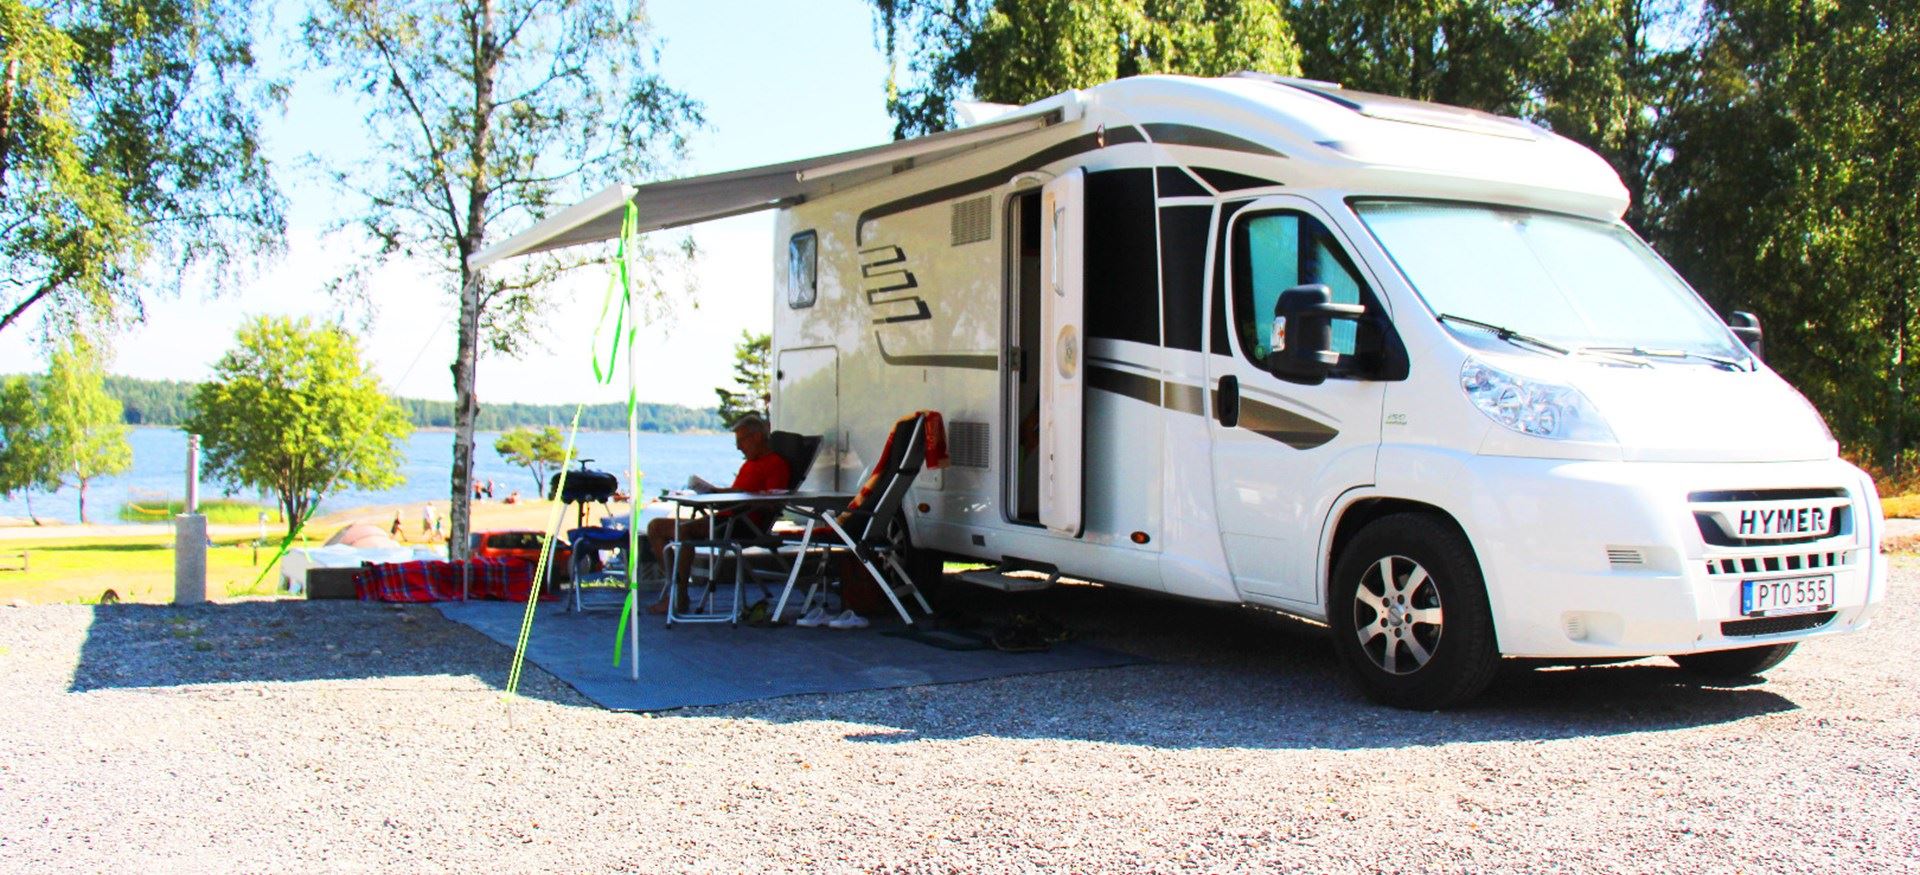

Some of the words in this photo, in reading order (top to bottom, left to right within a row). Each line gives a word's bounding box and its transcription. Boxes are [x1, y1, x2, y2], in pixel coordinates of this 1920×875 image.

[1739, 507, 1825, 534] HYMER
[1758, 583, 1790, 607] PTO
[1797, 580, 1826, 603] 555
